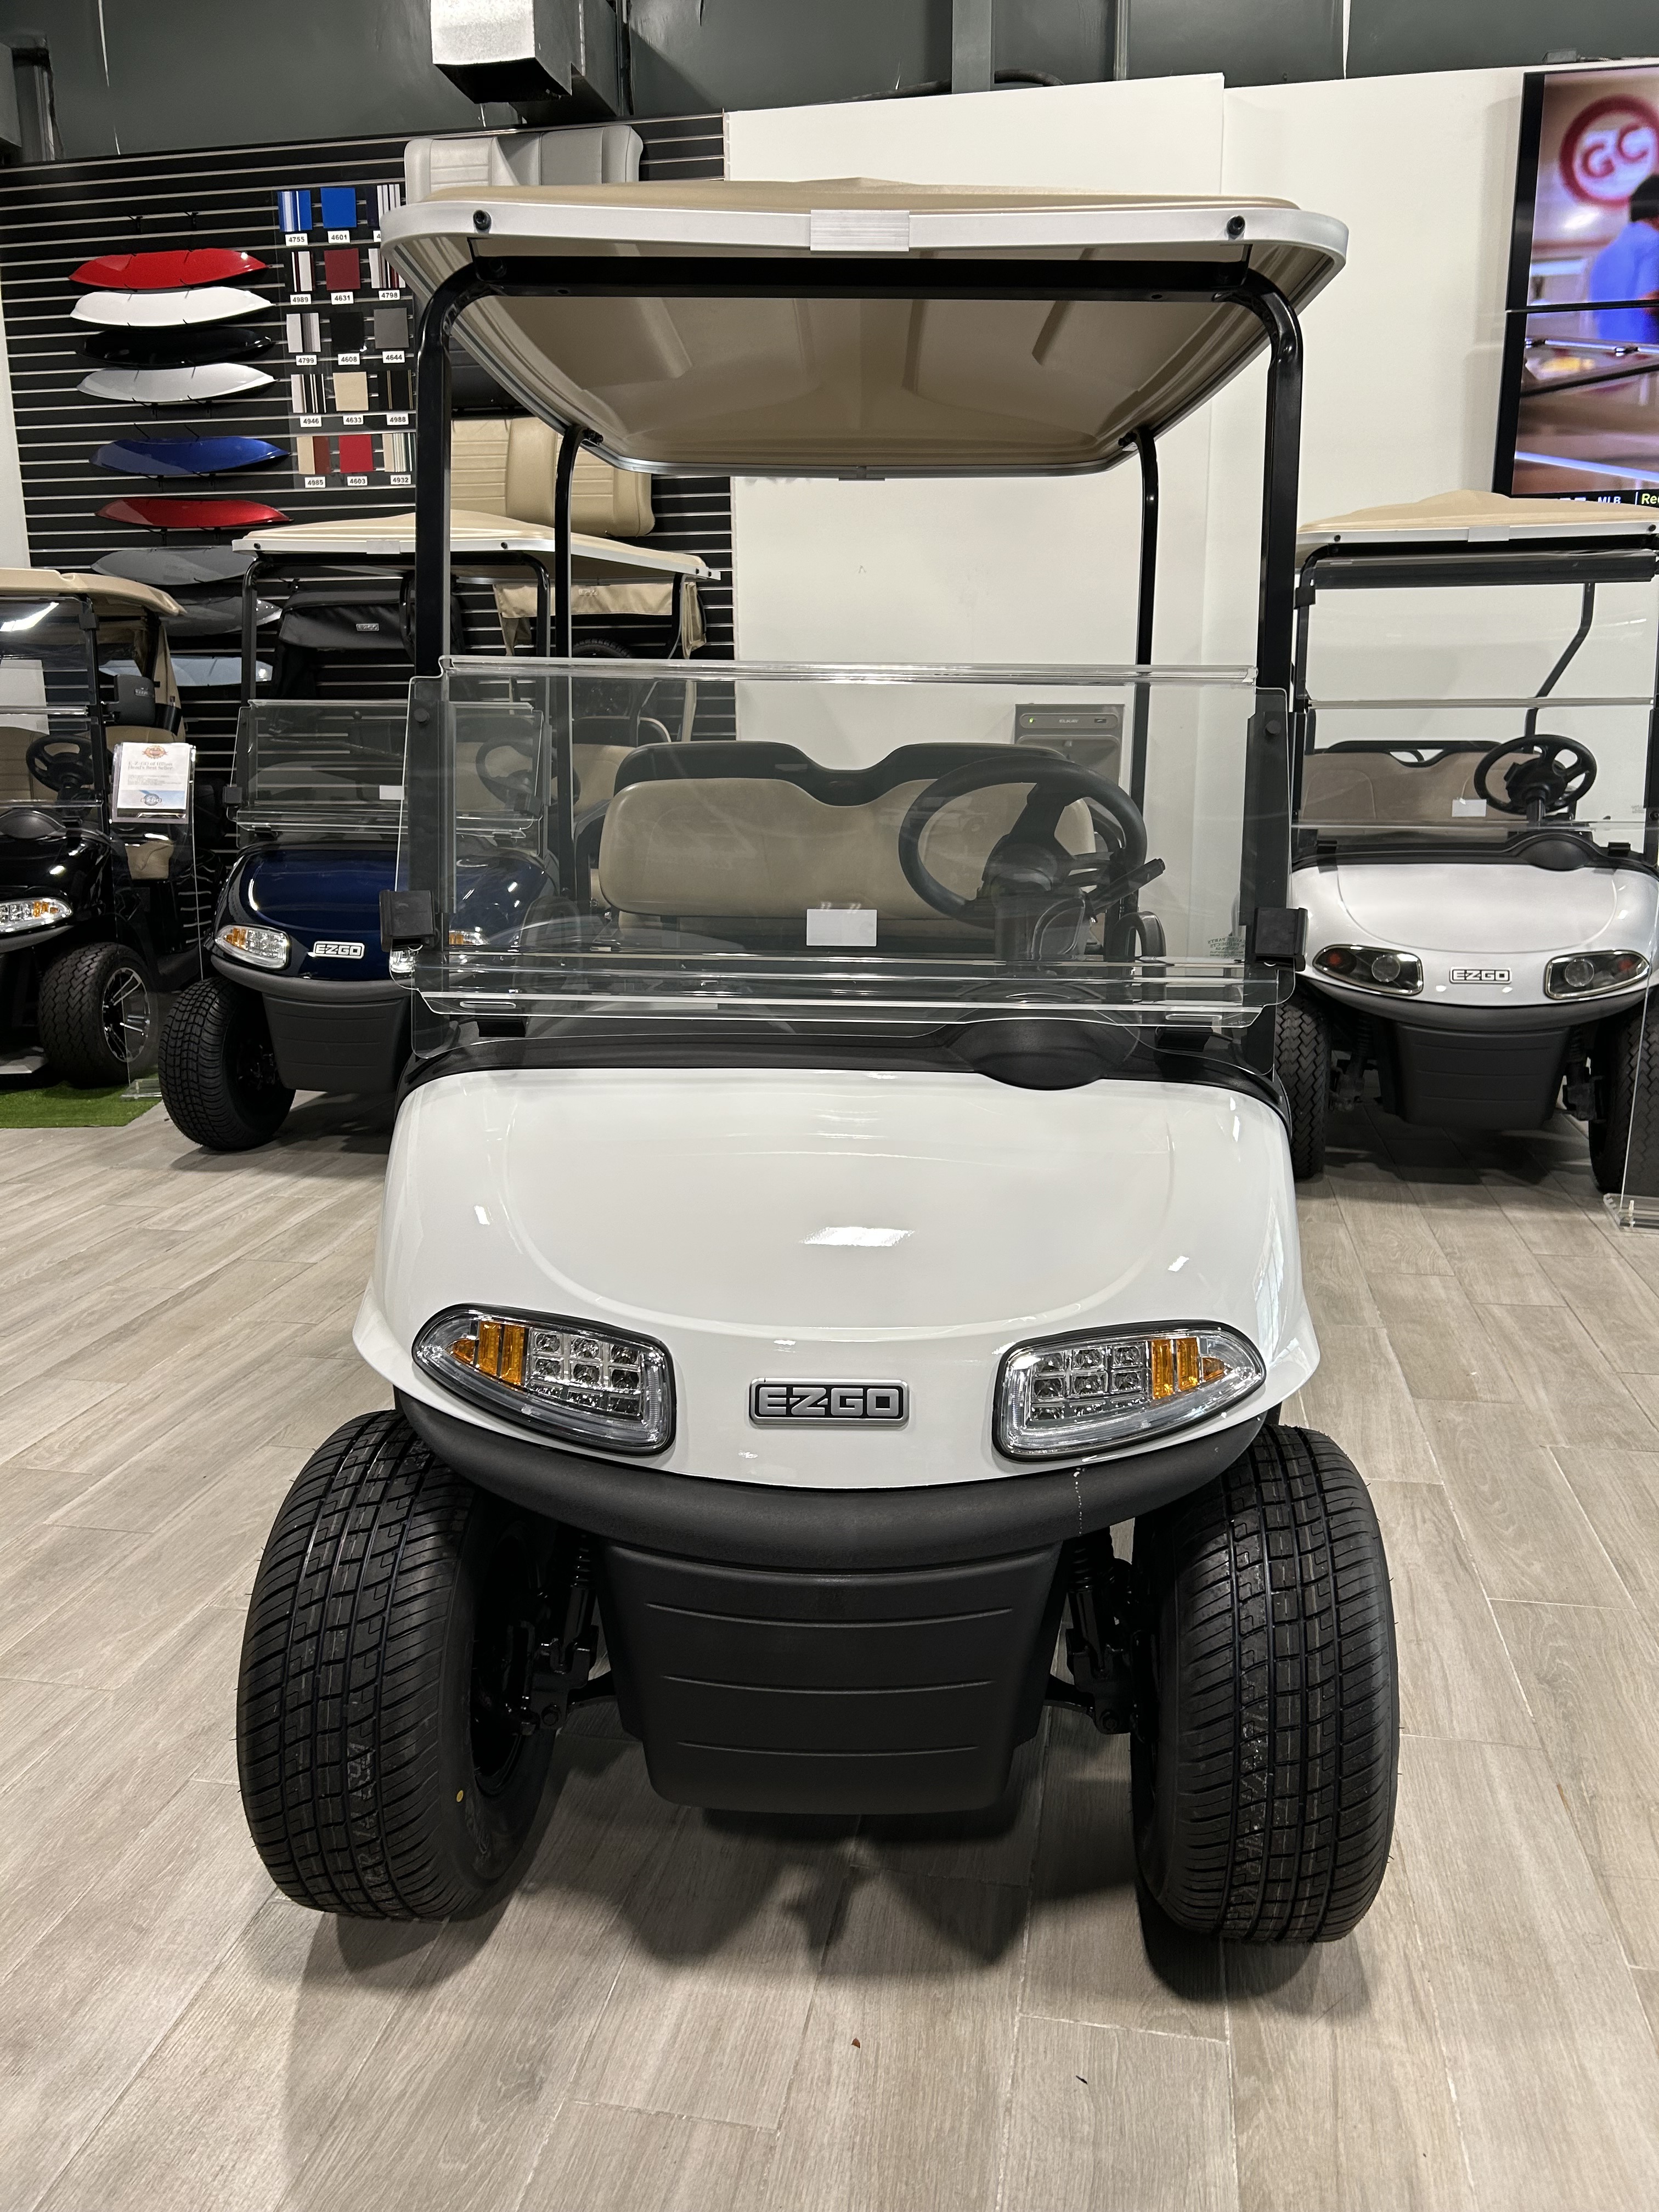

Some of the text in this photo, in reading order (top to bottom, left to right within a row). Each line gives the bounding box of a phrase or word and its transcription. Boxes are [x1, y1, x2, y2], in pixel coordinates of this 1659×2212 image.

[1641, 493, 1659, 505] Re
[315, 944, 362, 956] EZGO
[1452, 969, 1509, 981] EZGO
[758, 1386, 899, 1417] EZGO
